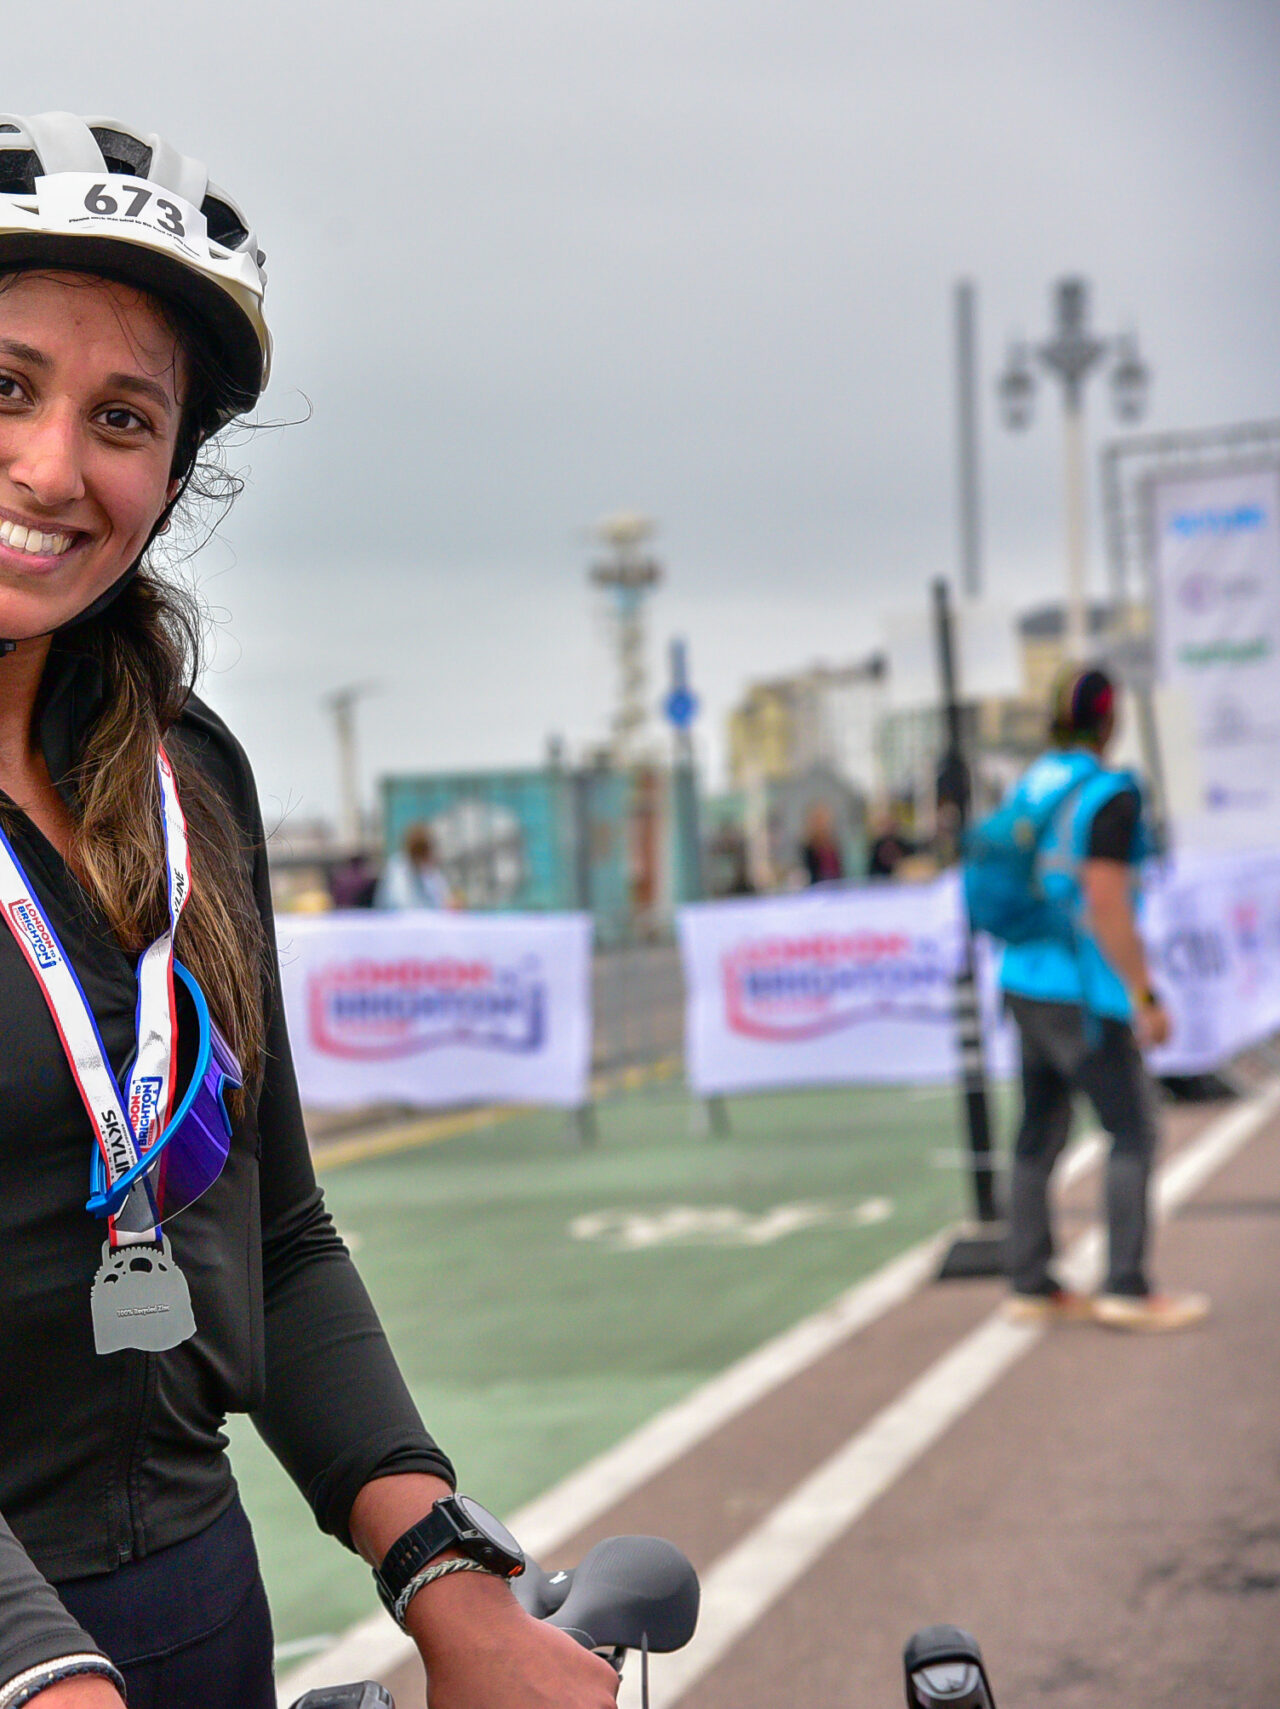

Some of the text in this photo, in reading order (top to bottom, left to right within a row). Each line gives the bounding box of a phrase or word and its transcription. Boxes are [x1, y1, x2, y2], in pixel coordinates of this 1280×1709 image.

[84, 183, 186, 238] 673
[17, 906, 52, 961] BRIGHTON
[25, 903, 57, 959] LONDON TO
[135, 1085, 142, 1095] TO
[137, 1083, 153, 1146] BRIGHTON
